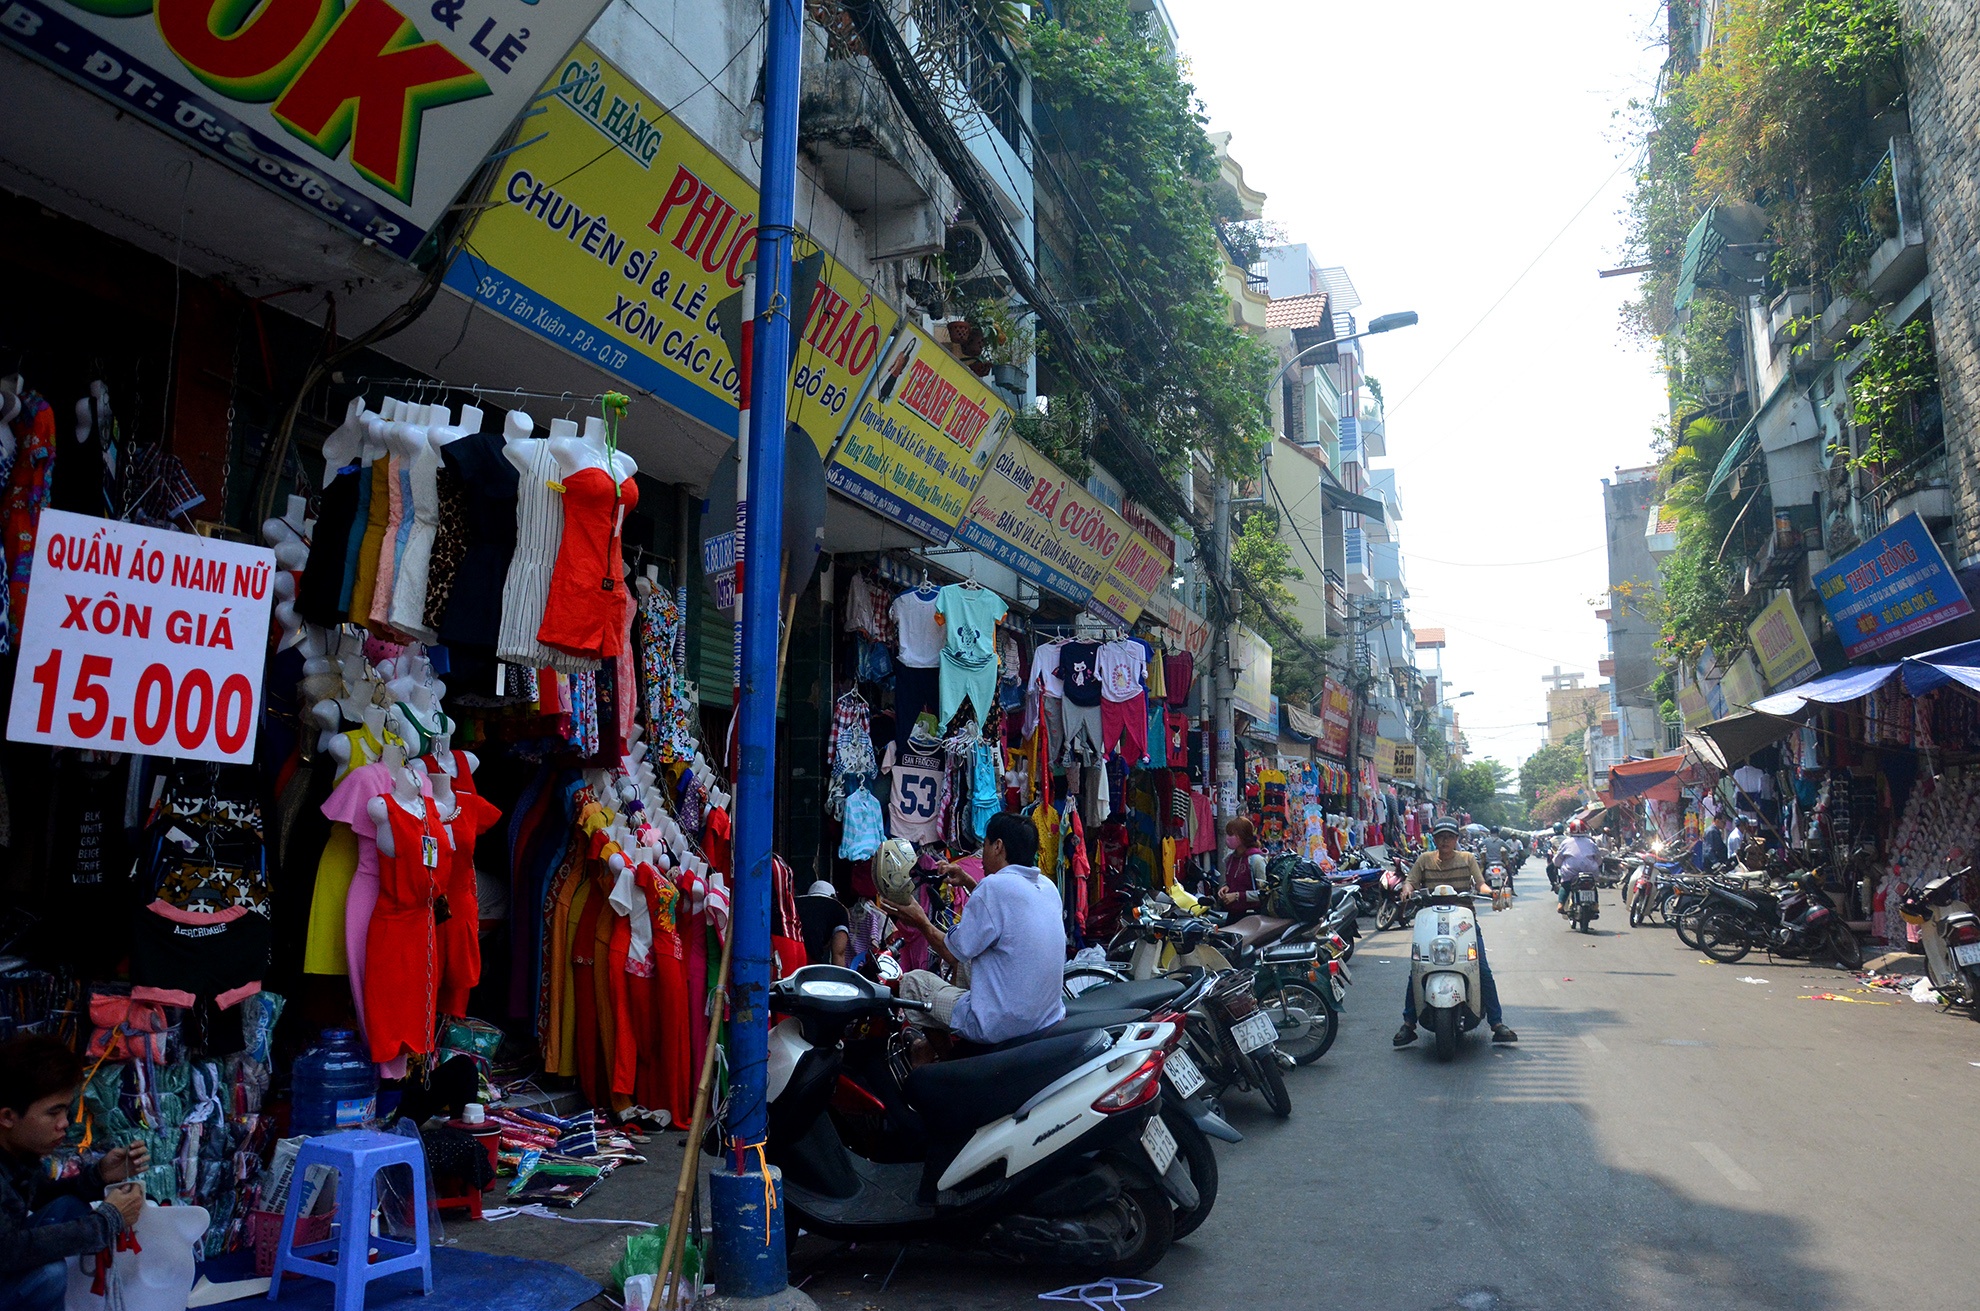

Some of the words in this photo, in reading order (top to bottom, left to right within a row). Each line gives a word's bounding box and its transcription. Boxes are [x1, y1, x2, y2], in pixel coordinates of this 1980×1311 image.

[469, 17, 529, 75] LẺ
[82, 48, 164, 109] ĐT:
[558, 61, 610, 115] CỬA
[604, 100, 663, 164] HÀNG
[475, 275, 502, 296] Số
[497, 290, 509, 305] 3
[507, 294, 532, 319] Tân
[531, 305, 565, 337] Xuân
[570, 328, 592, 351] P.8
[597, 345, 630, 371] Q.TB
[507, 170, 625, 266] CHUYÊN
[627, 247, 658, 285] SỈ
[651, 269, 671, 297] &
[674, 282, 708, 320] LẺ
[793, 364, 823, 398] ĐỒ
[819, 384, 848, 418] BỘ
[605, 293, 664, 346] XÔN
[664, 324, 711, 375] CÁC
[898, 358, 959, 430] THANH
[844, 434, 865, 465] Hàng
[860, 443, 884, 472] Thanh
[882, 417, 896, 442] Bán
[996, 451, 1014, 475] CỬA
[1012, 464, 1035, 491] HÀNG
[957, 518, 970, 535] 5
[965, 525, 980, 543] TÂN
[978, 533, 998, 552] XUÂN
[996, 510, 1017, 533] BÁN
[1012, 517, 1026, 539] SỈ
[1020, 523, 1035, 543] VÀ
[1030, 528, 1049, 551] LẺ
[1060, 500, 1120, 558] CƯỜNG
[47, 526, 123, 577] QUẦN
[128, 539, 165, 584] ÁO
[171, 554, 228, 594] NAM
[232, 560, 272, 600] NỮ
[1115, 539, 1147, 580] LONG
[1846, 559, 1882, 595] THÚY
[1876, 538, 1919, 577] HỒNG
[60, 591, 152, 639] XÔN
[165, 607, 234, 650] GIÁ
[33, 648, 253, 754] 15.000
[900, 774, 937, 817] 53
[78, 848, 100, 859] BEIGE
[1156, 1134, 1175, 1168] 3179
